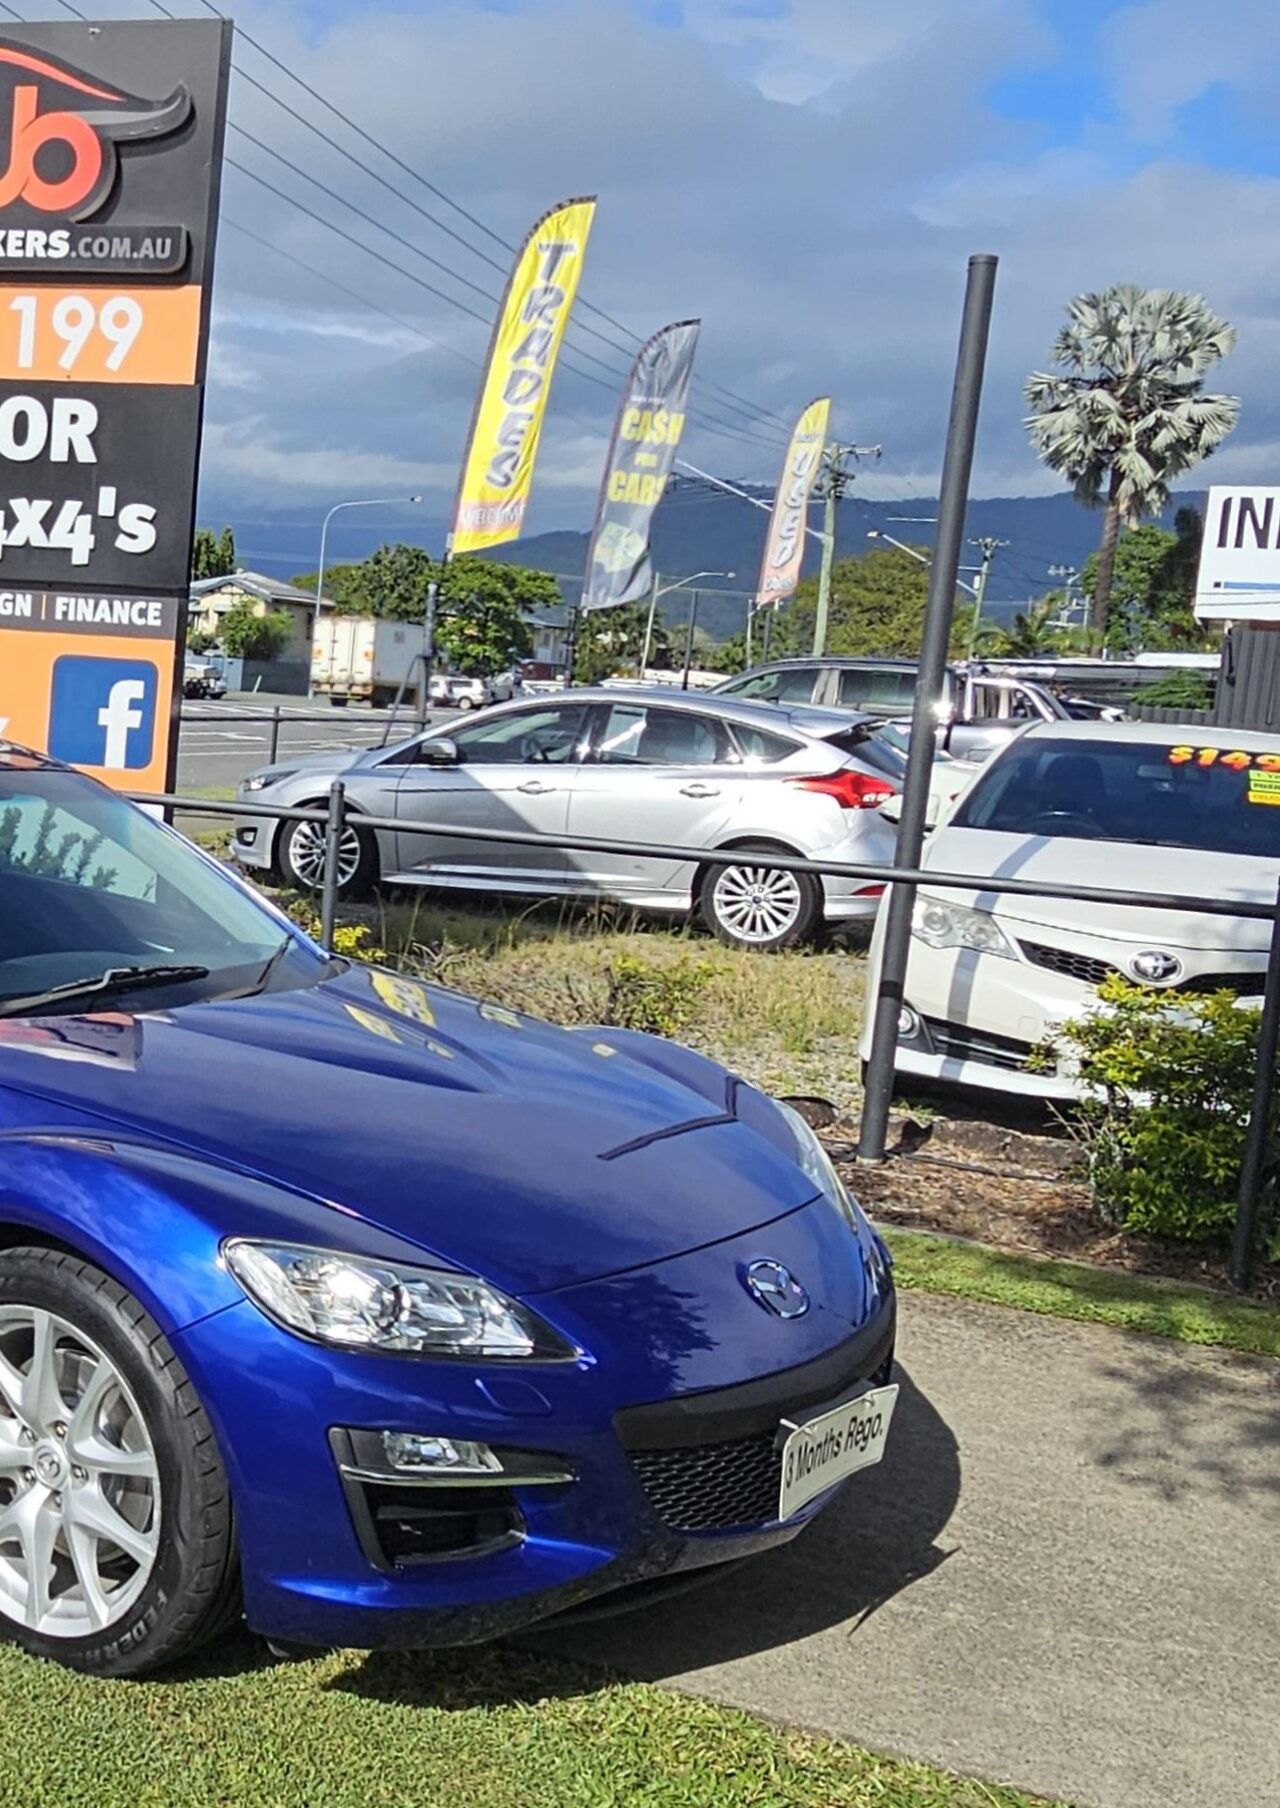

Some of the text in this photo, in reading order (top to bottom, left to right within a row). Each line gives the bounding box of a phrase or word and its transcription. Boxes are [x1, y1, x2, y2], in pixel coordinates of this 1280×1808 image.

[8, 294, 144, 373] 199
[485, 242, 577, 488] TRADES
[621, 407, 685, 445] CASH
[1217, 496, 1280, 550] IN
[54, 598, 162, 627] FINANCE
[784, 1412, 884, 1490] 3 Months Rego.
